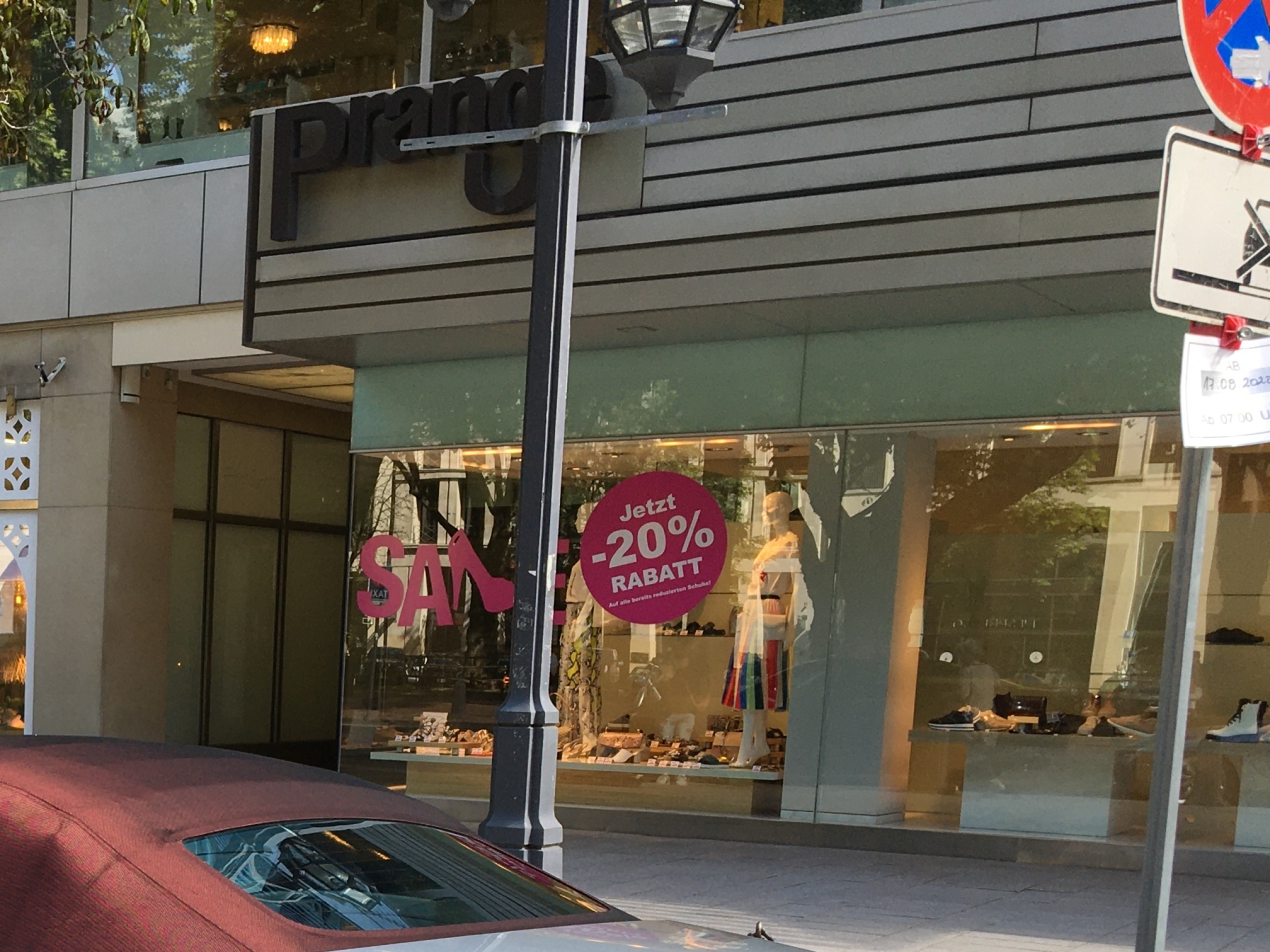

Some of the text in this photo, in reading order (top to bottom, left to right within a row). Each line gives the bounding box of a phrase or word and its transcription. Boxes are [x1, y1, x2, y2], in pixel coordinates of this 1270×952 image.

[619, 493, 676, 522] Jetzt
[591, 509, 715, 569] -20%
[611, 556, 702, 593] RABATT
